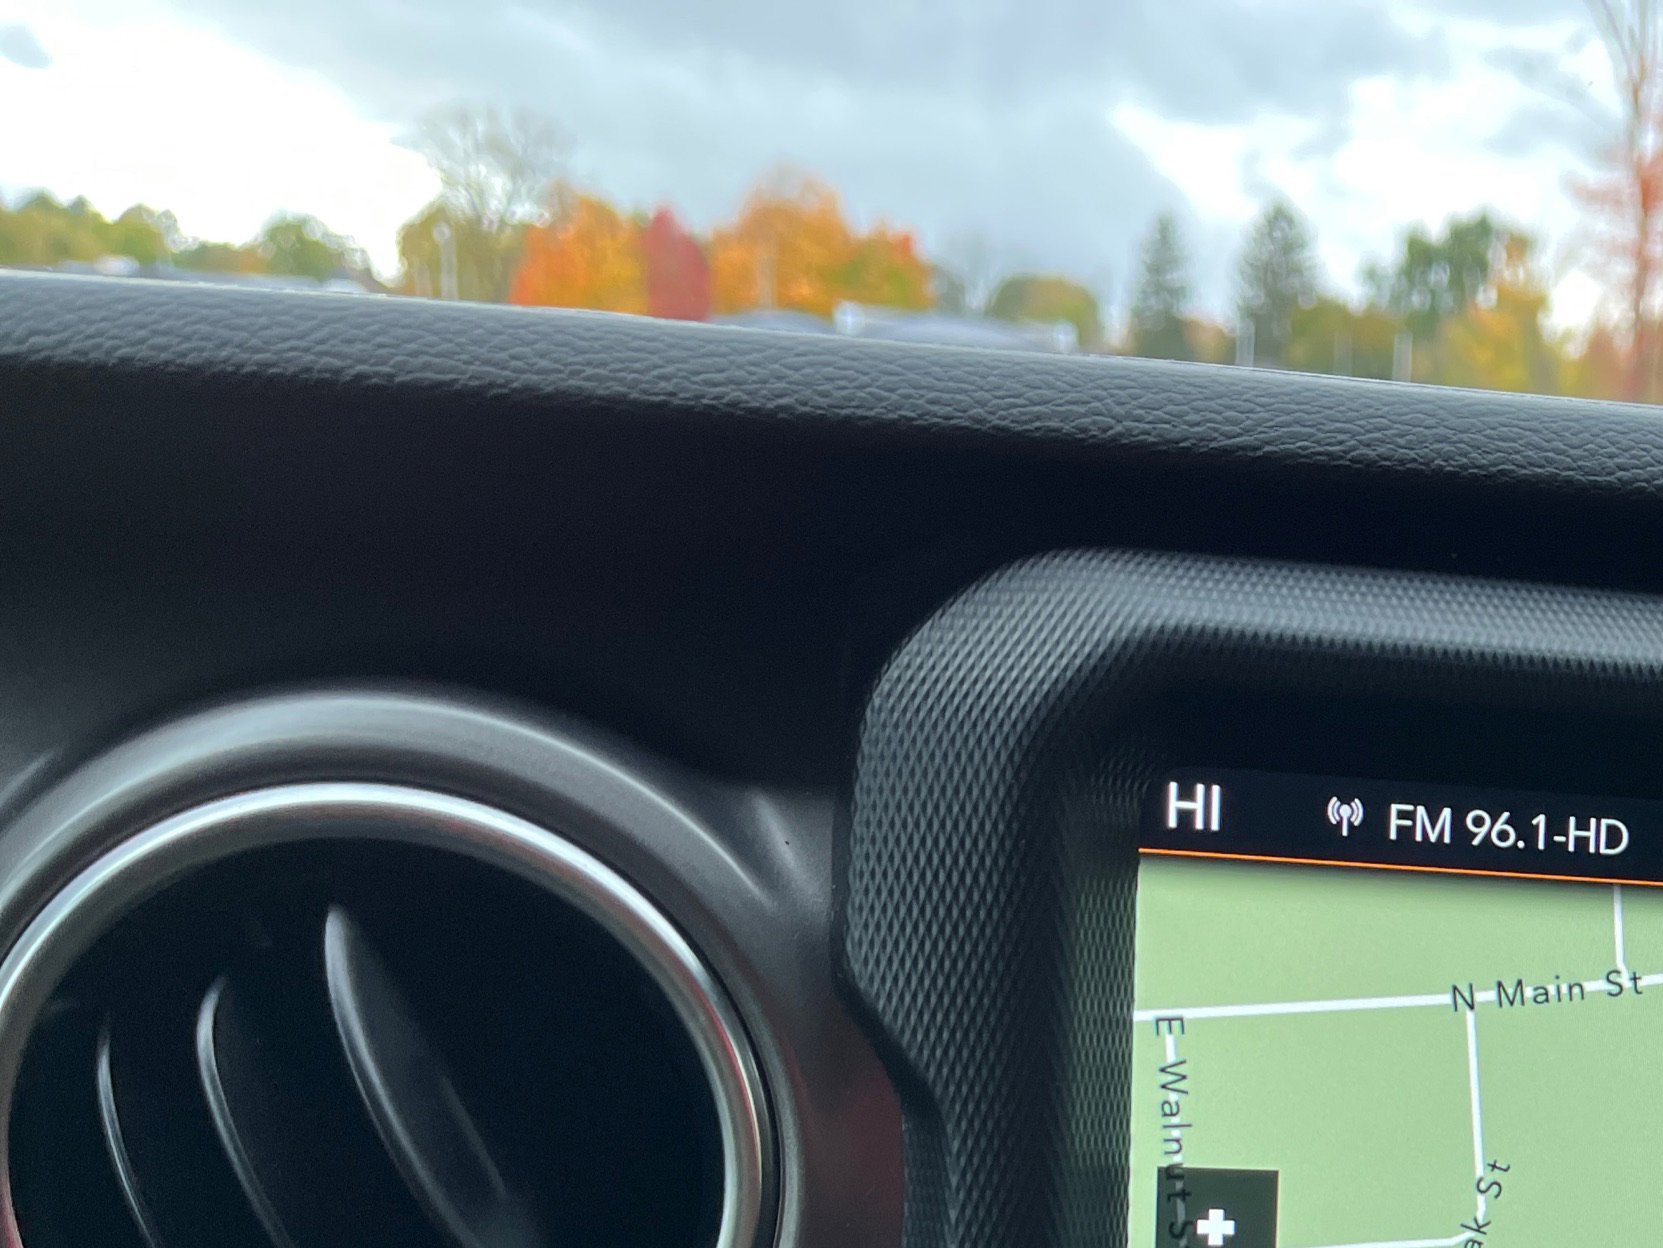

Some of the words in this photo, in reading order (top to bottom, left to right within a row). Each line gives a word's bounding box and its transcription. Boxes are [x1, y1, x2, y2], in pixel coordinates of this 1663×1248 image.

[1166, 781, 1222, 832] HI
[1388, 802, 1452, 844] FM
[1464, 808, 1630, 856] 96.1-HD
[1451, 982, 1477, 1013] N
[1495, 978, 1587, 1009] Main
[1603, 969, 1645, 998] St
[1154, 1015, 1186, 1037] E
[1158, 1059, 1194, 1204] Walnut
[1476, 1158, 1511, 1199] St
